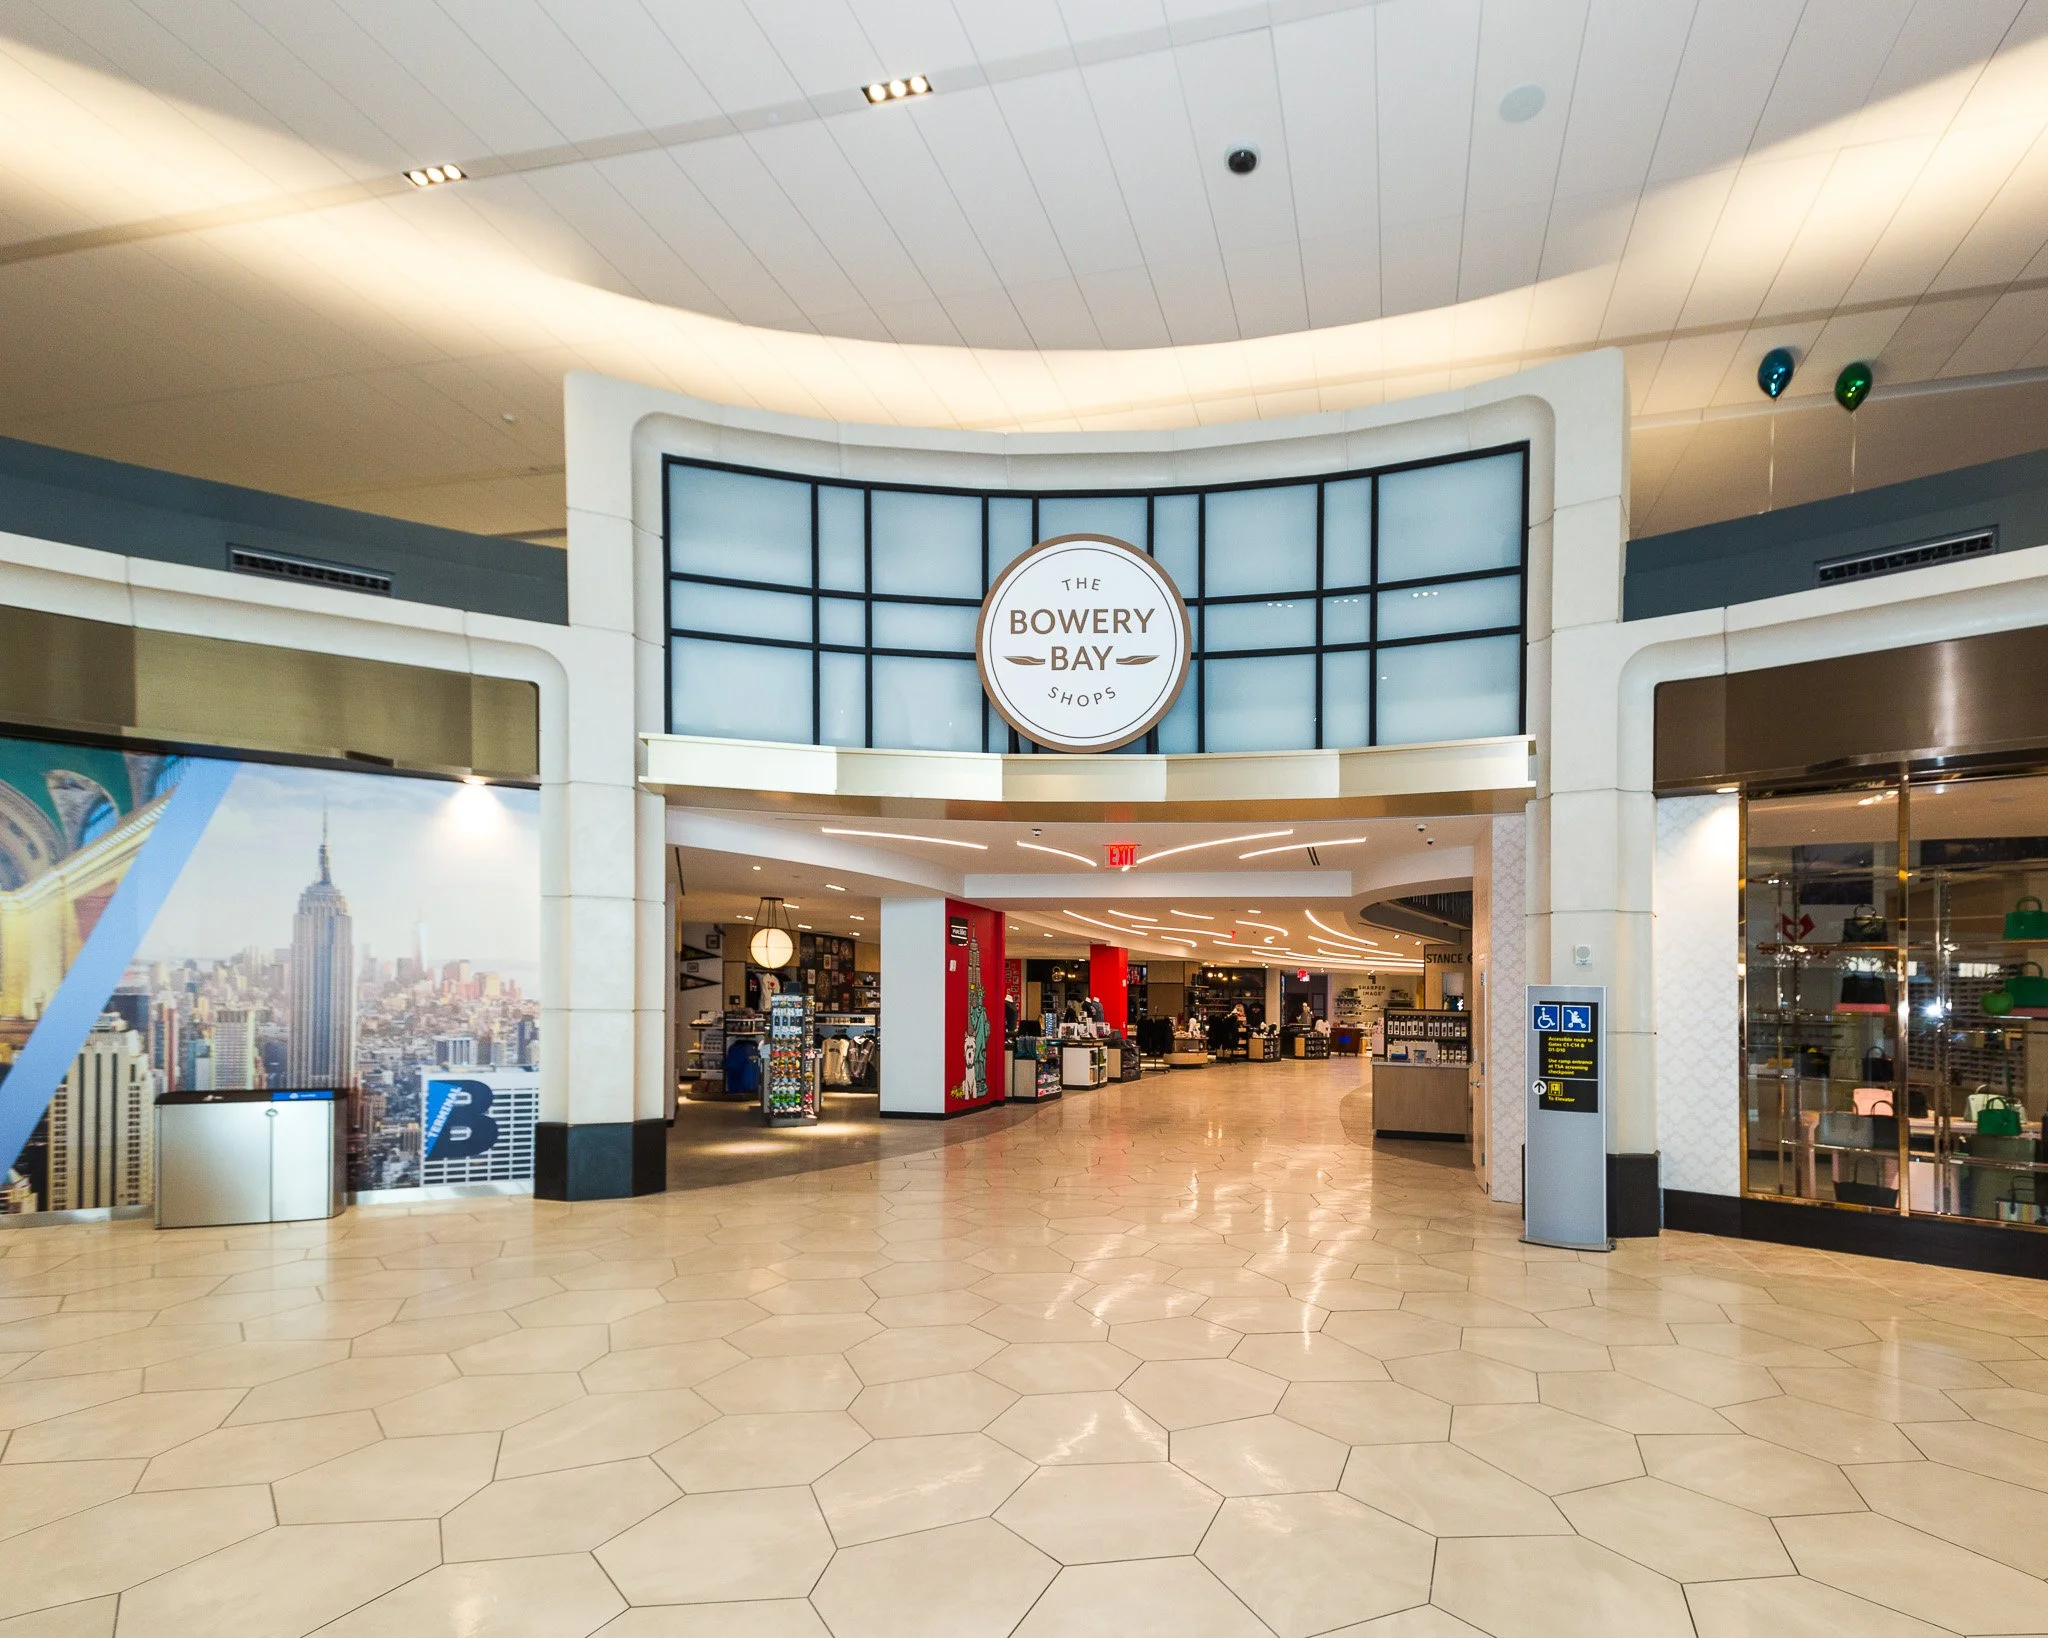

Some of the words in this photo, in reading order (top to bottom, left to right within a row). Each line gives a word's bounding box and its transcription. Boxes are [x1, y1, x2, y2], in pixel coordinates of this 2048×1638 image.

[1061, 577, 1101, 592] THE
[1010, 608, 1156, 635] BOWERY
[1051, 645, 1113, 671] BAY
[1047, 686, 1117, 707] SHOPS
[1109, 846, 1135, 866] EXIT
[1426, 953, 1464, 964] STANCE
[426, 1086, 462, 1138] TERMINAL
